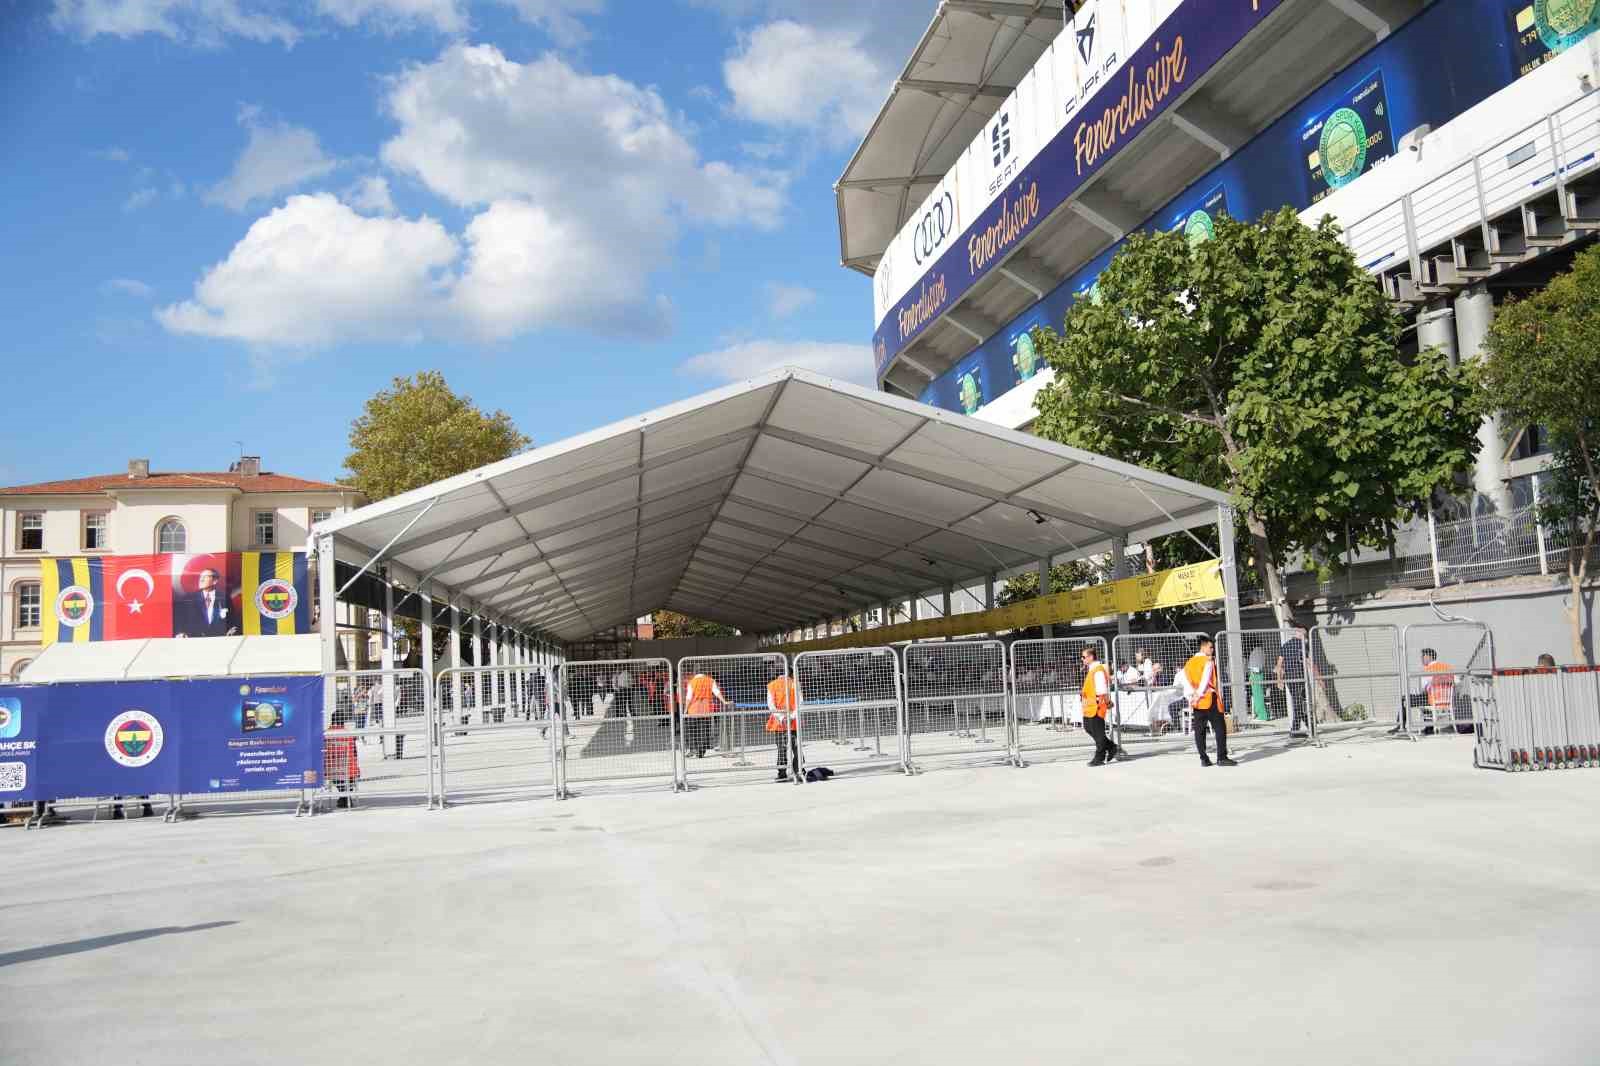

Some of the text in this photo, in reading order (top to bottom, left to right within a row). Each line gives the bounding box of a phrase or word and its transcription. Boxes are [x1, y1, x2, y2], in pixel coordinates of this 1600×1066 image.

[1065, 52, 1117, 115] CUPRA
[1073, 35, 1187, 176] Fenerclusive
[988, 156, 1019, 196] SEAT
[967, 181, 1040, 275] Fenerclusive
[898, 273, 947, 342] Fenerclusive
